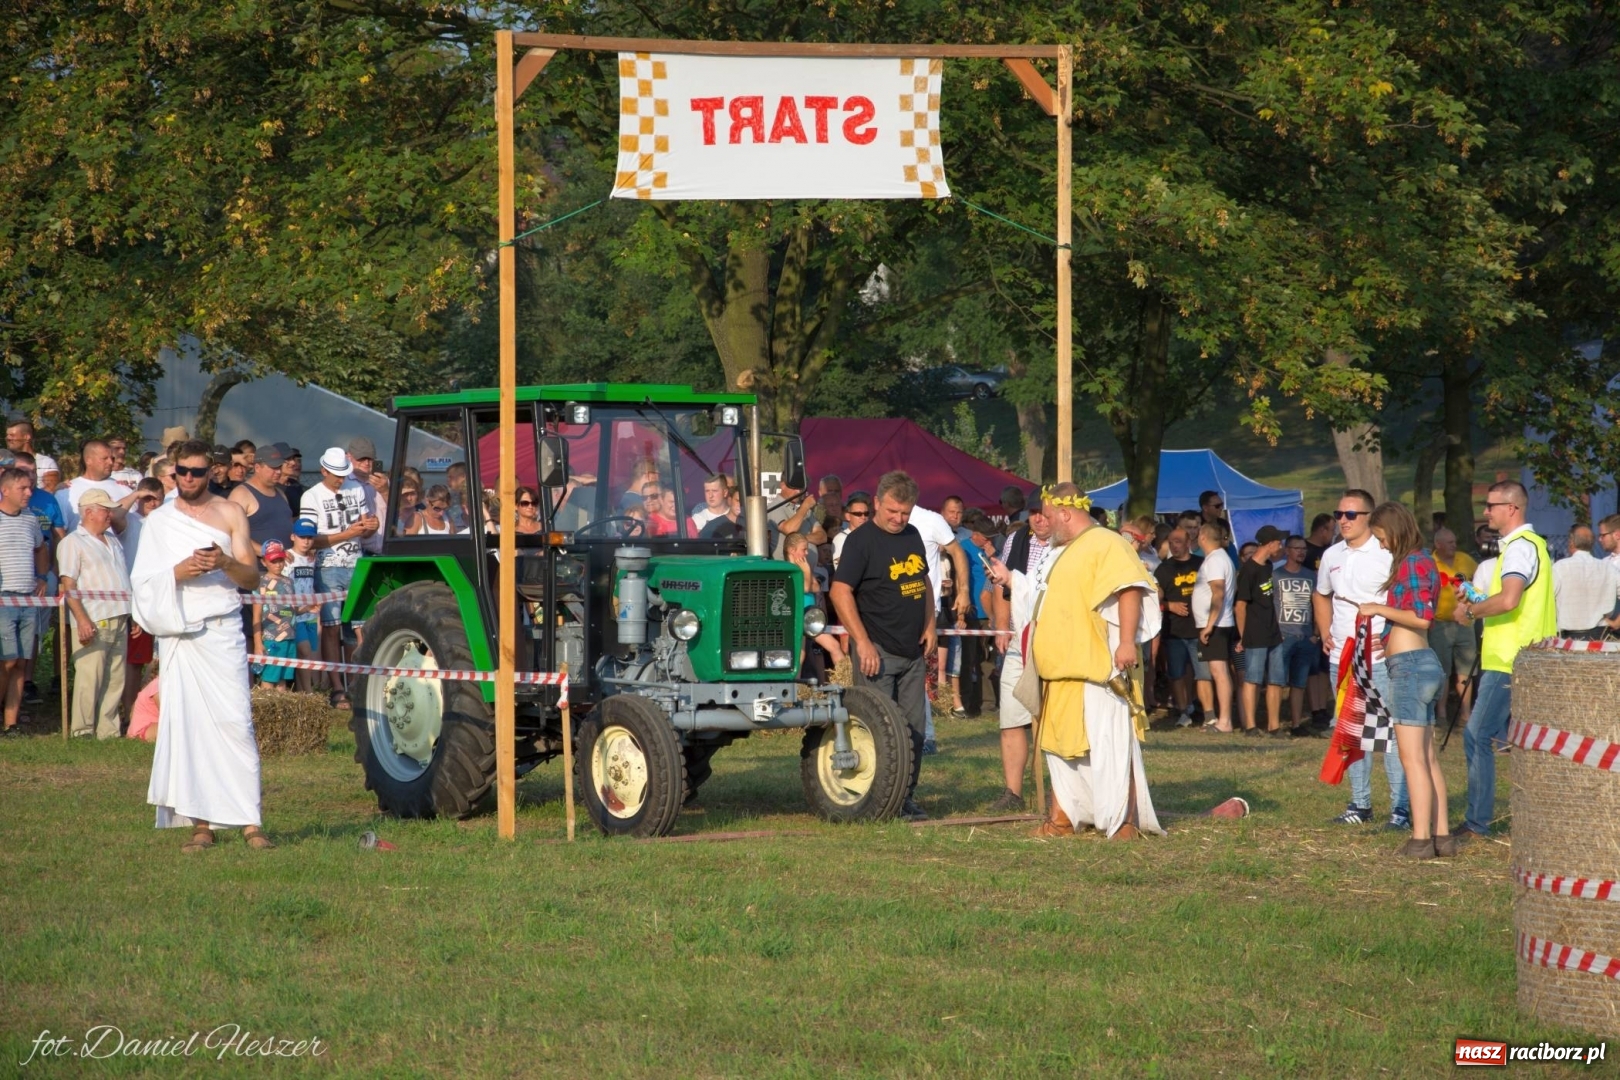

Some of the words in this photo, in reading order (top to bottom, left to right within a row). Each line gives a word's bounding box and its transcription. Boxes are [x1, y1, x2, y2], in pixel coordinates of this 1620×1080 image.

[661, 580, 700, 591] URSUS
[1281, 580, 1312, 592] USA
[1283, 608, 1310, 622] USA
